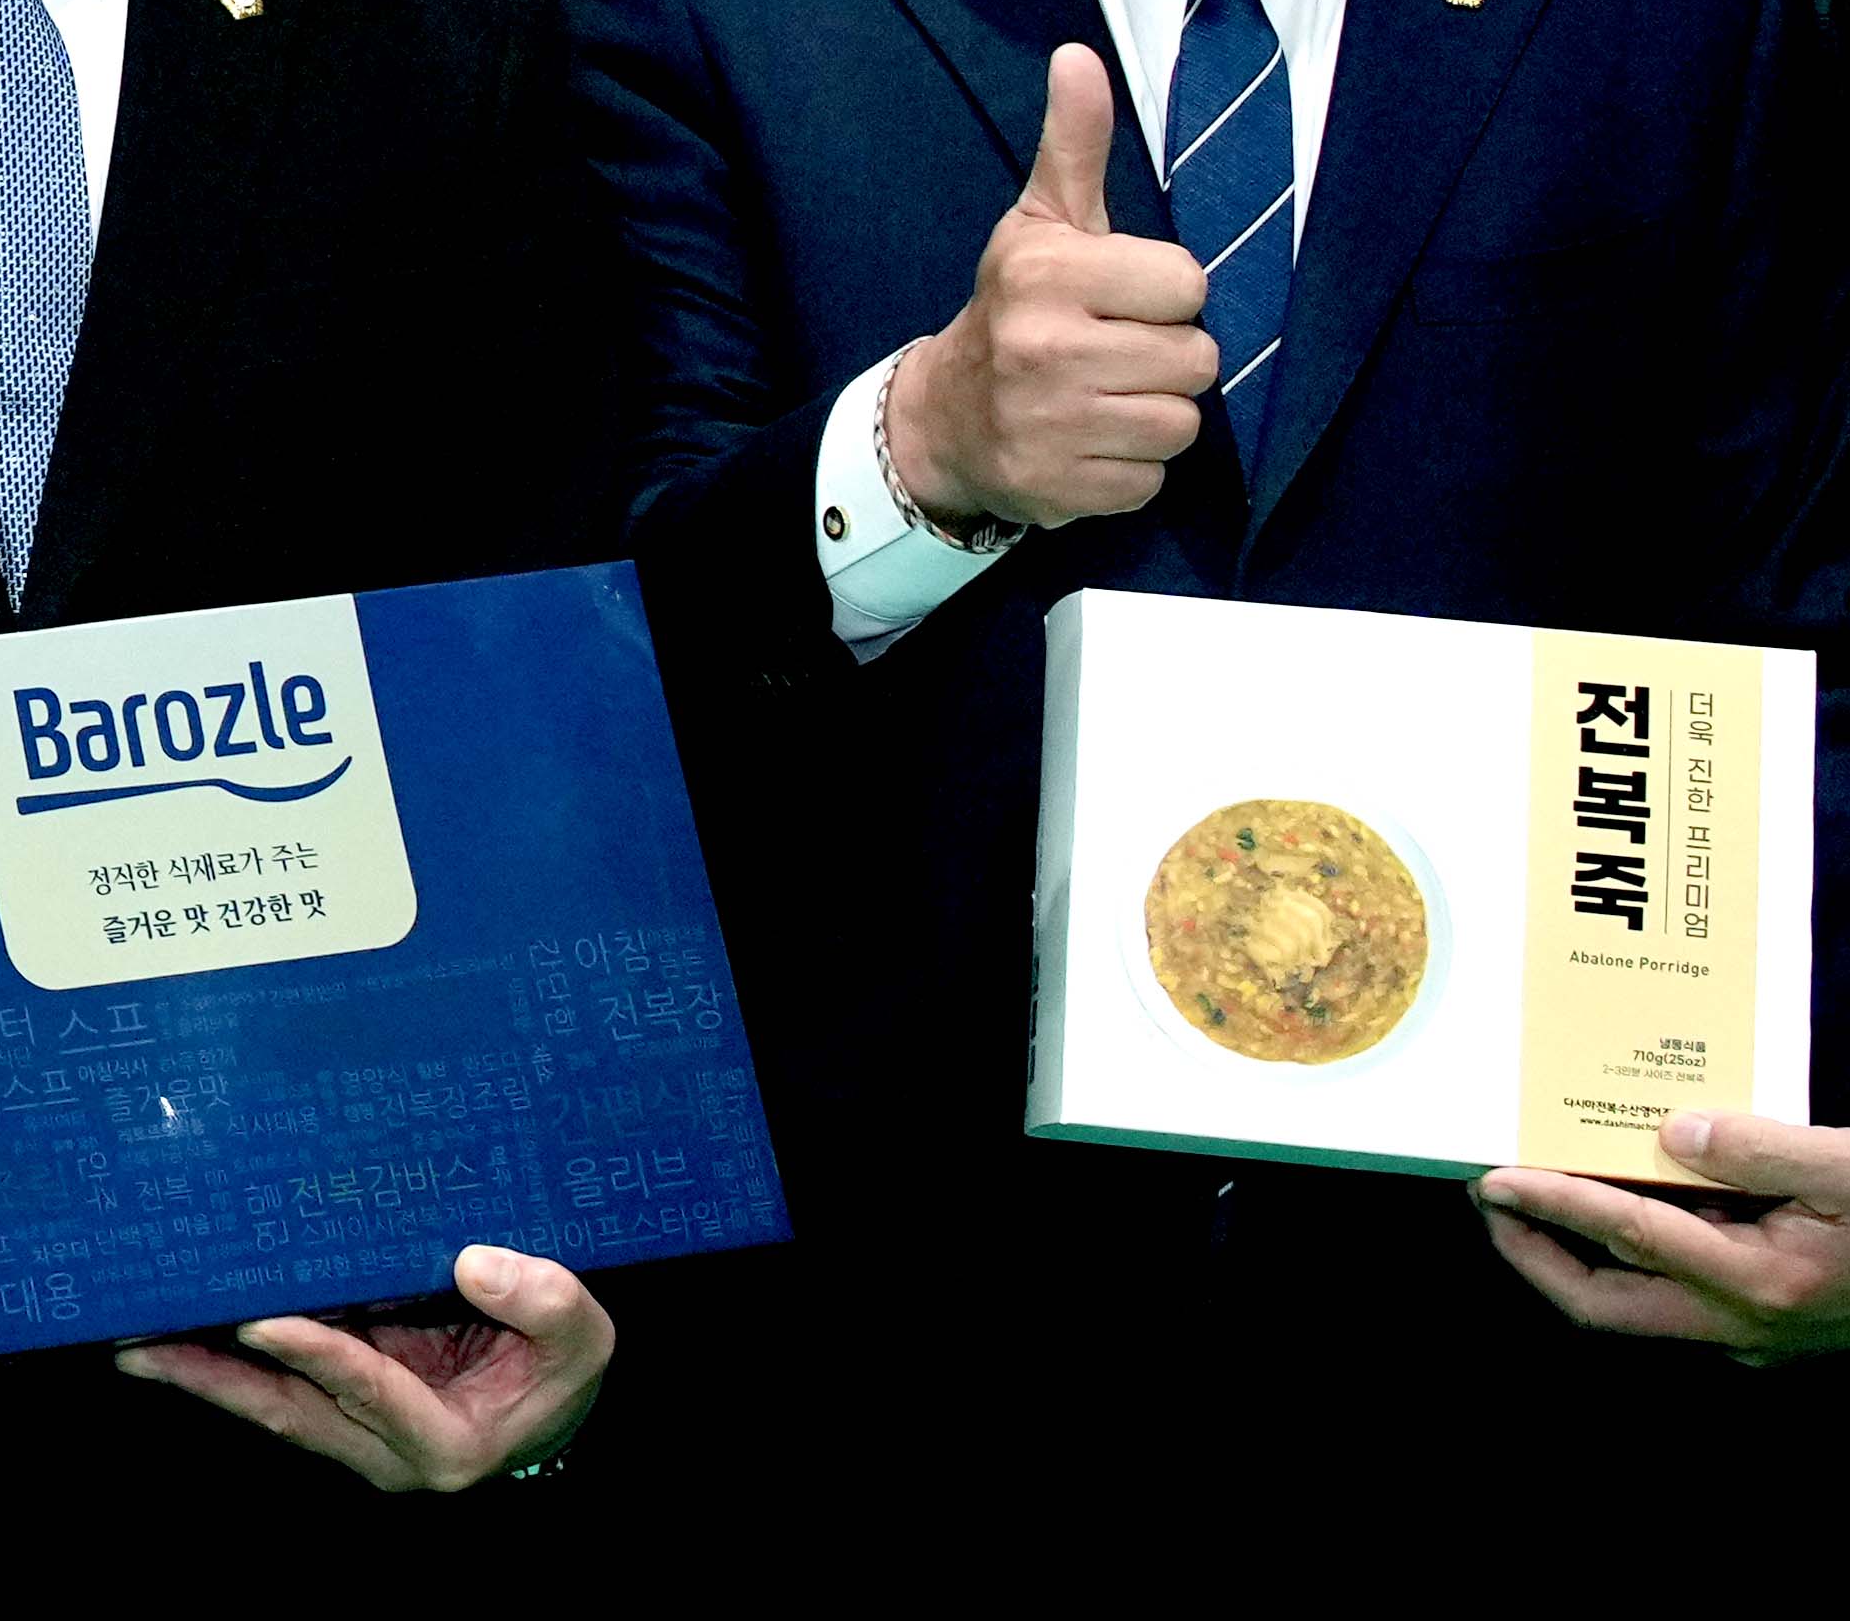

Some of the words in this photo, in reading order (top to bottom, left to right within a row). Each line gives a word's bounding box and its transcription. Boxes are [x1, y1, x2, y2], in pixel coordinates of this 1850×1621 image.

[13, 660, 333, 780] Barozle
[1686, 691, 1717, 748] 더욱
[1570, 681, 1652, 933] 전복죽
[1686, 755, 1715, 813] 진한
[88, 860, 160, 896] 정직한
[168, 847, 264, 884] 식재료가
[271, 841, 319, 873] 주는
[1684, 826, 1713, 940] 프리미엄
[103, 909, 177, 944] 즐거운
[183, 904, 211, 933] 맛
[217, 893, 293, 929] 건강한
[299, 888, 327, 919] 맛
[575, 929, 650, 975] 아침
[1569, 949, 1635, 971] Abalone
[1638, 955, 1711, 979] Porridge
[59, 1003, 156, 1055] 스프
[599, 980, 722, 1041] 전복장
[1633, 1049, 1707, 1068] 710g(25oz)
[134, 1177, 195, 1211] 전복
[288, 1155, 484, 1218] 전복감바스
[563, 1147, 696, 1208] 올리브
